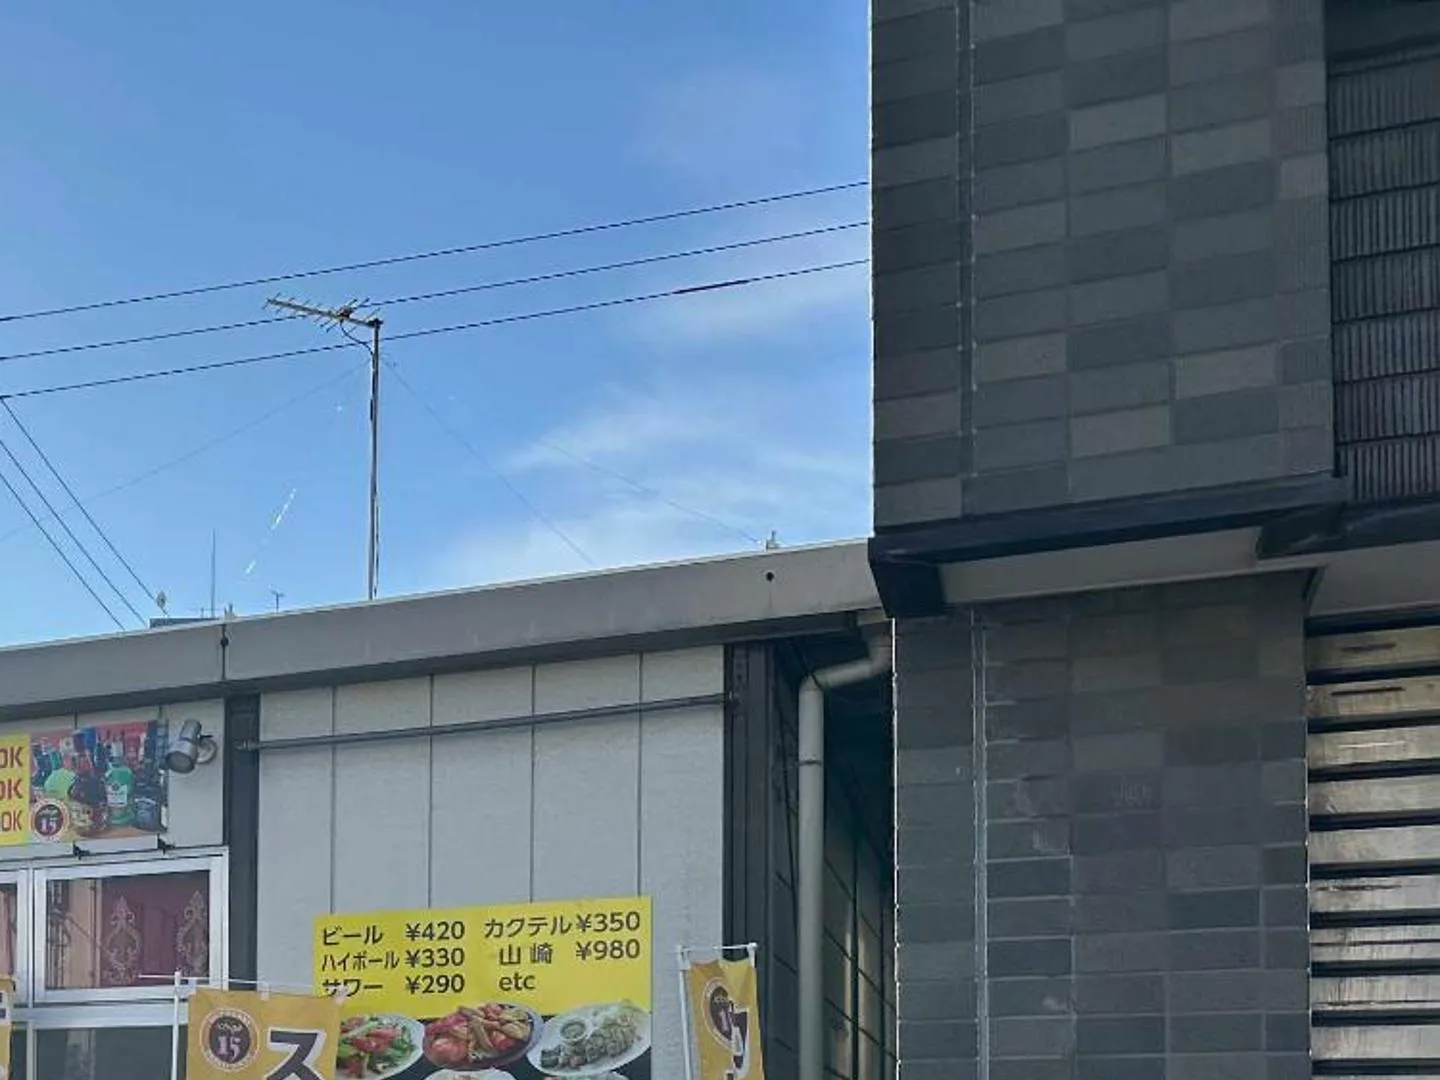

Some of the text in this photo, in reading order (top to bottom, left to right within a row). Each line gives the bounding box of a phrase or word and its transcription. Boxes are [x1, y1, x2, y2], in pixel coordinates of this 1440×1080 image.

[322, 920, 466, 946] ビール ¥420
[484, 910, 641, 939] カクテル ¥350
[321, 947, 466, 972] ハイボール ¥330
[575, 938, 641, 961] ¥980
[322, 973, 466, 998] サワー ¥290
[499, 972, 536, 992] etc
[217, 1035, 242, 1061] 15
